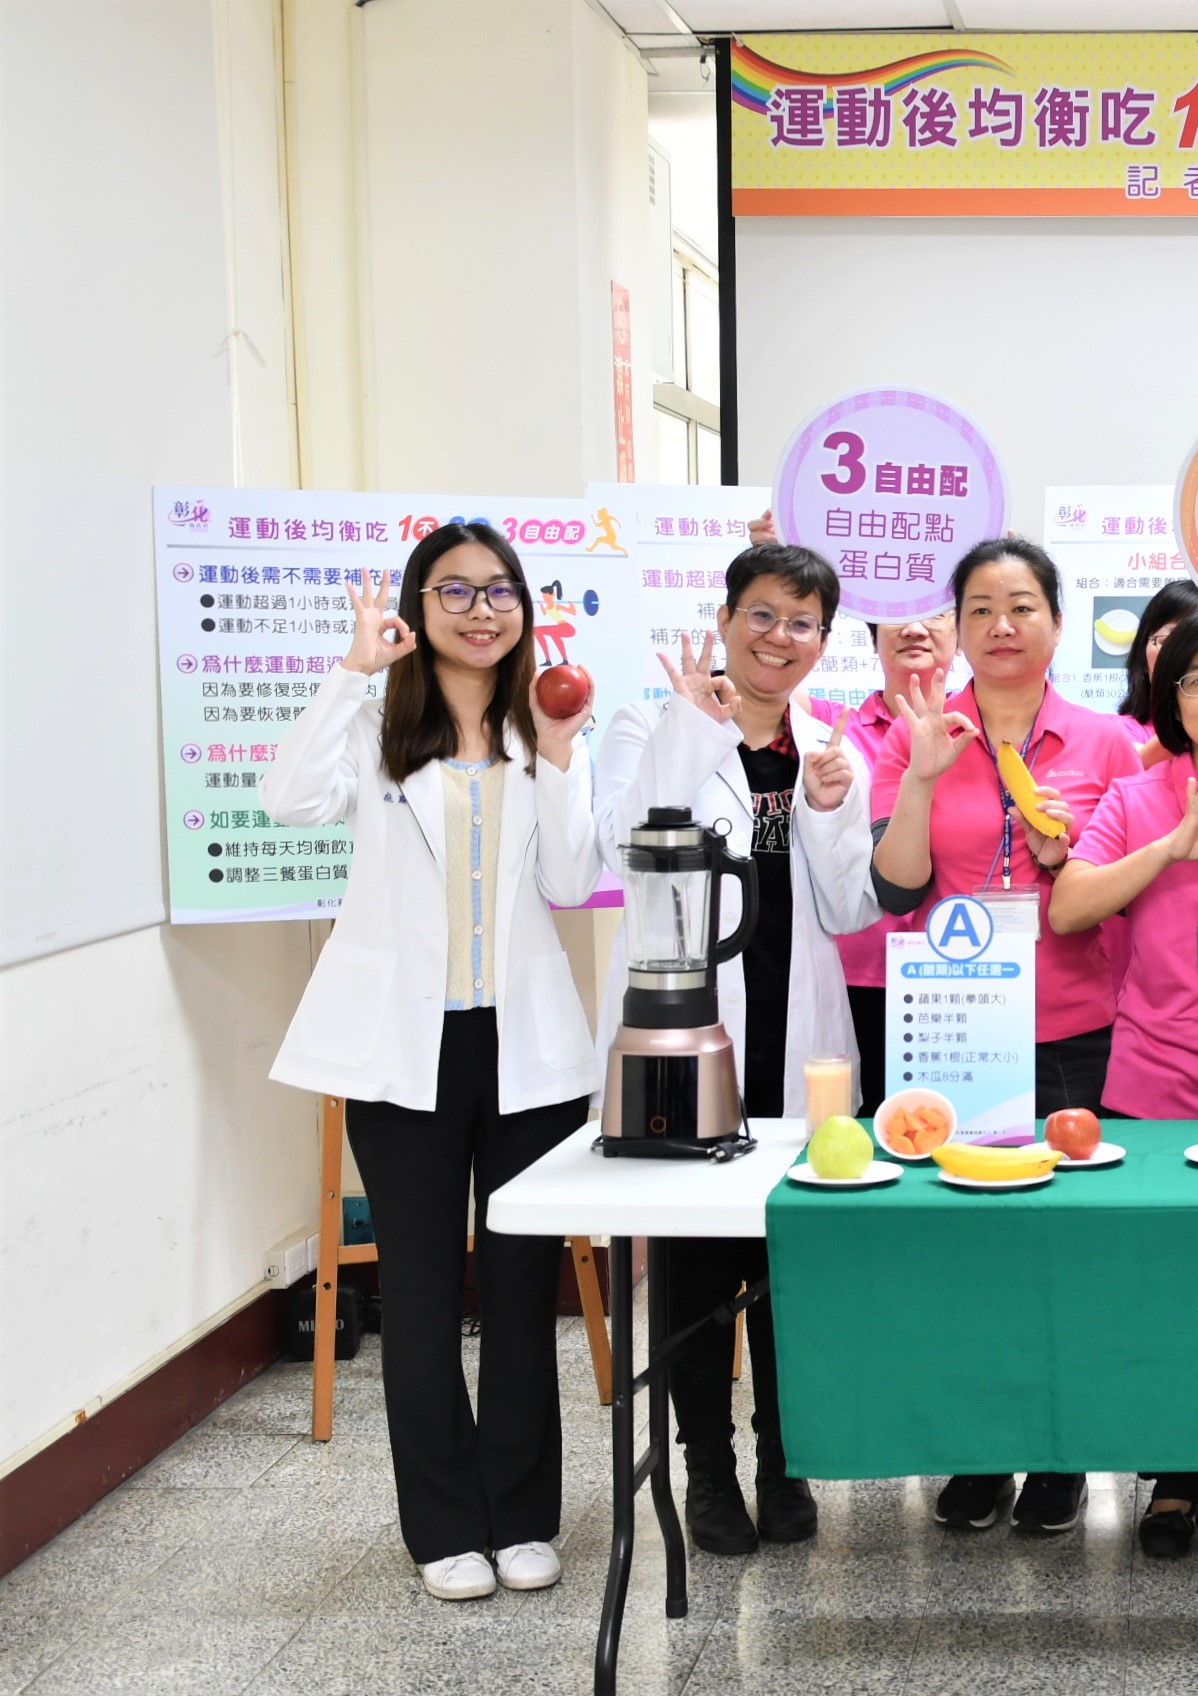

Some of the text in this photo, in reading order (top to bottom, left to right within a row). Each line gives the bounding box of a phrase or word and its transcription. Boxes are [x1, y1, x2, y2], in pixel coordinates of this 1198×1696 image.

[769, 87, 1156, 148] 運動後均衡吃
[228, 516, 389, 543] 運動後均衡吃
[825, 507, 955, 543] 自由配點
[838, 549, 936, 583] 蛋白質
[938, 903, 982, 947] A
